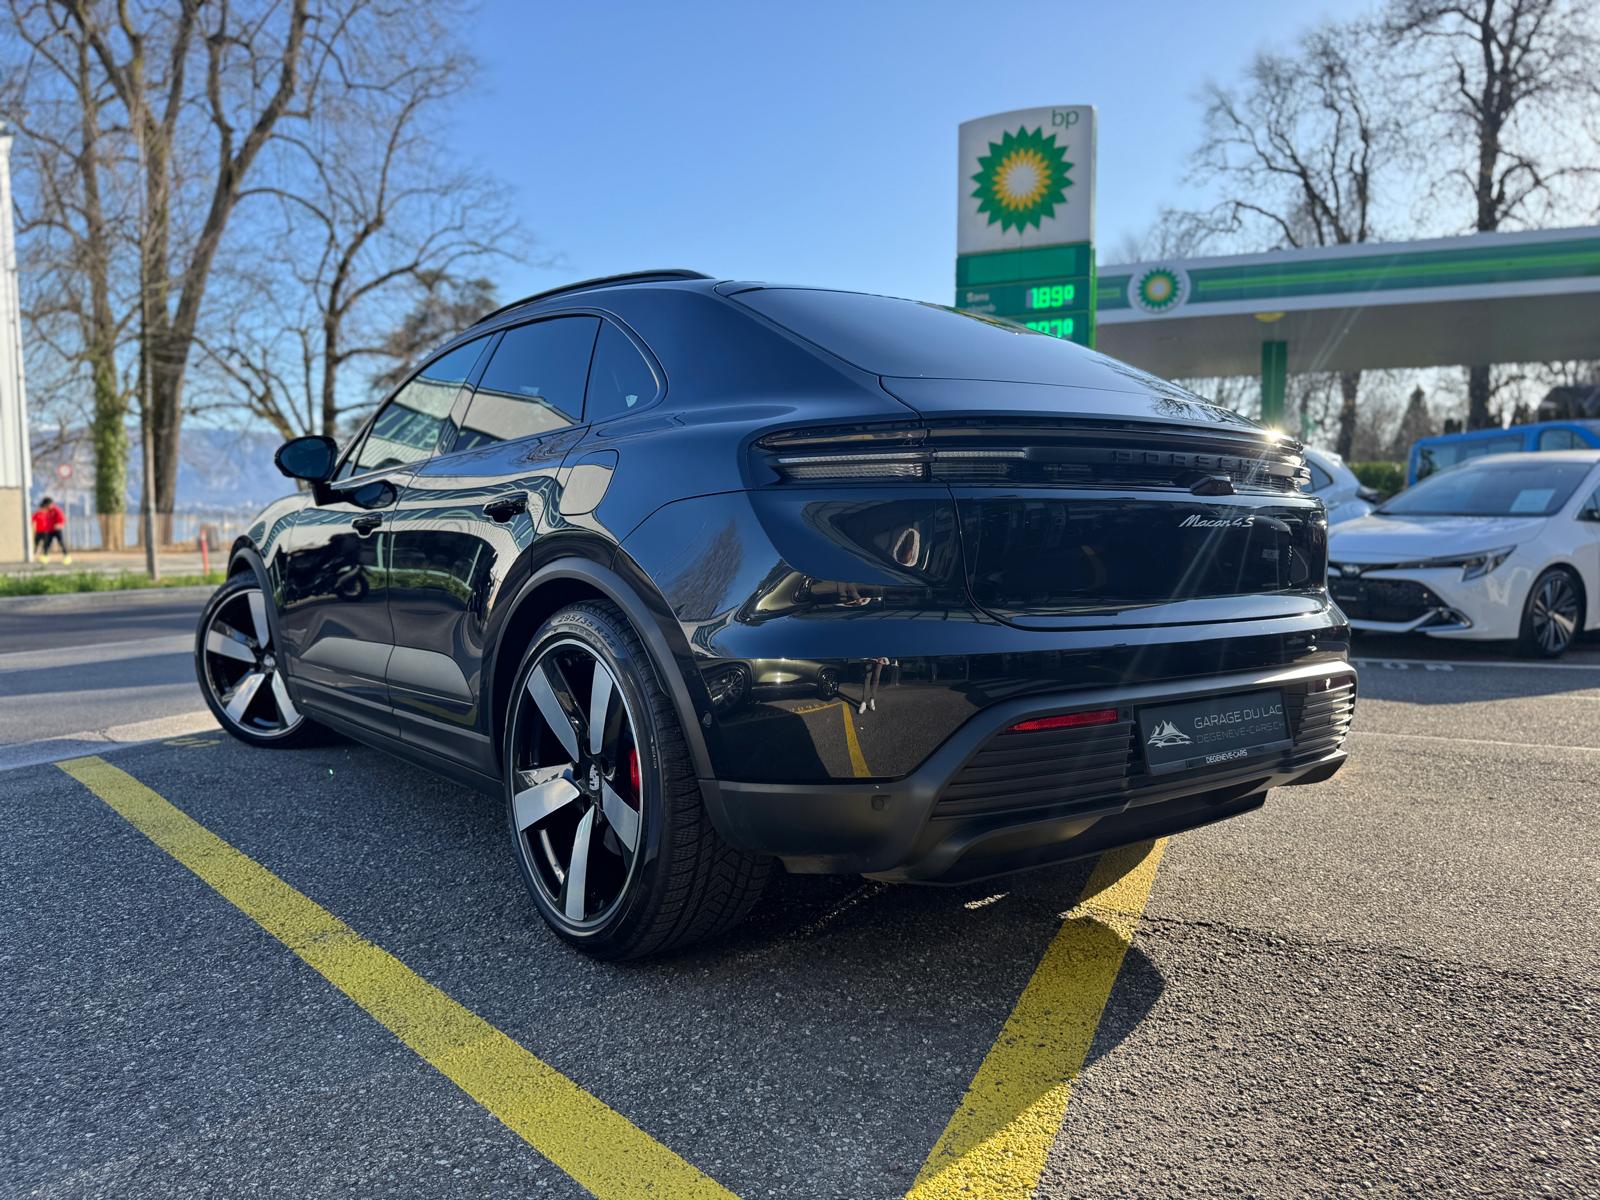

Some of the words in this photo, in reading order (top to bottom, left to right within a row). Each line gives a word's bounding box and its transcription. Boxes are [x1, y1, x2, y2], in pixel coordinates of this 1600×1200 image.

[1052, 109, 1079, 129] bp
[1178, 514, 1231, 528] Macan
[1194, 710, 1242, 729] GARAGE
[1243, 708, 1260, 721] DU
[1261, 704, 1283, 717] LAC
[1205, 748, 1249, 764] DEGENEVE-CARS
